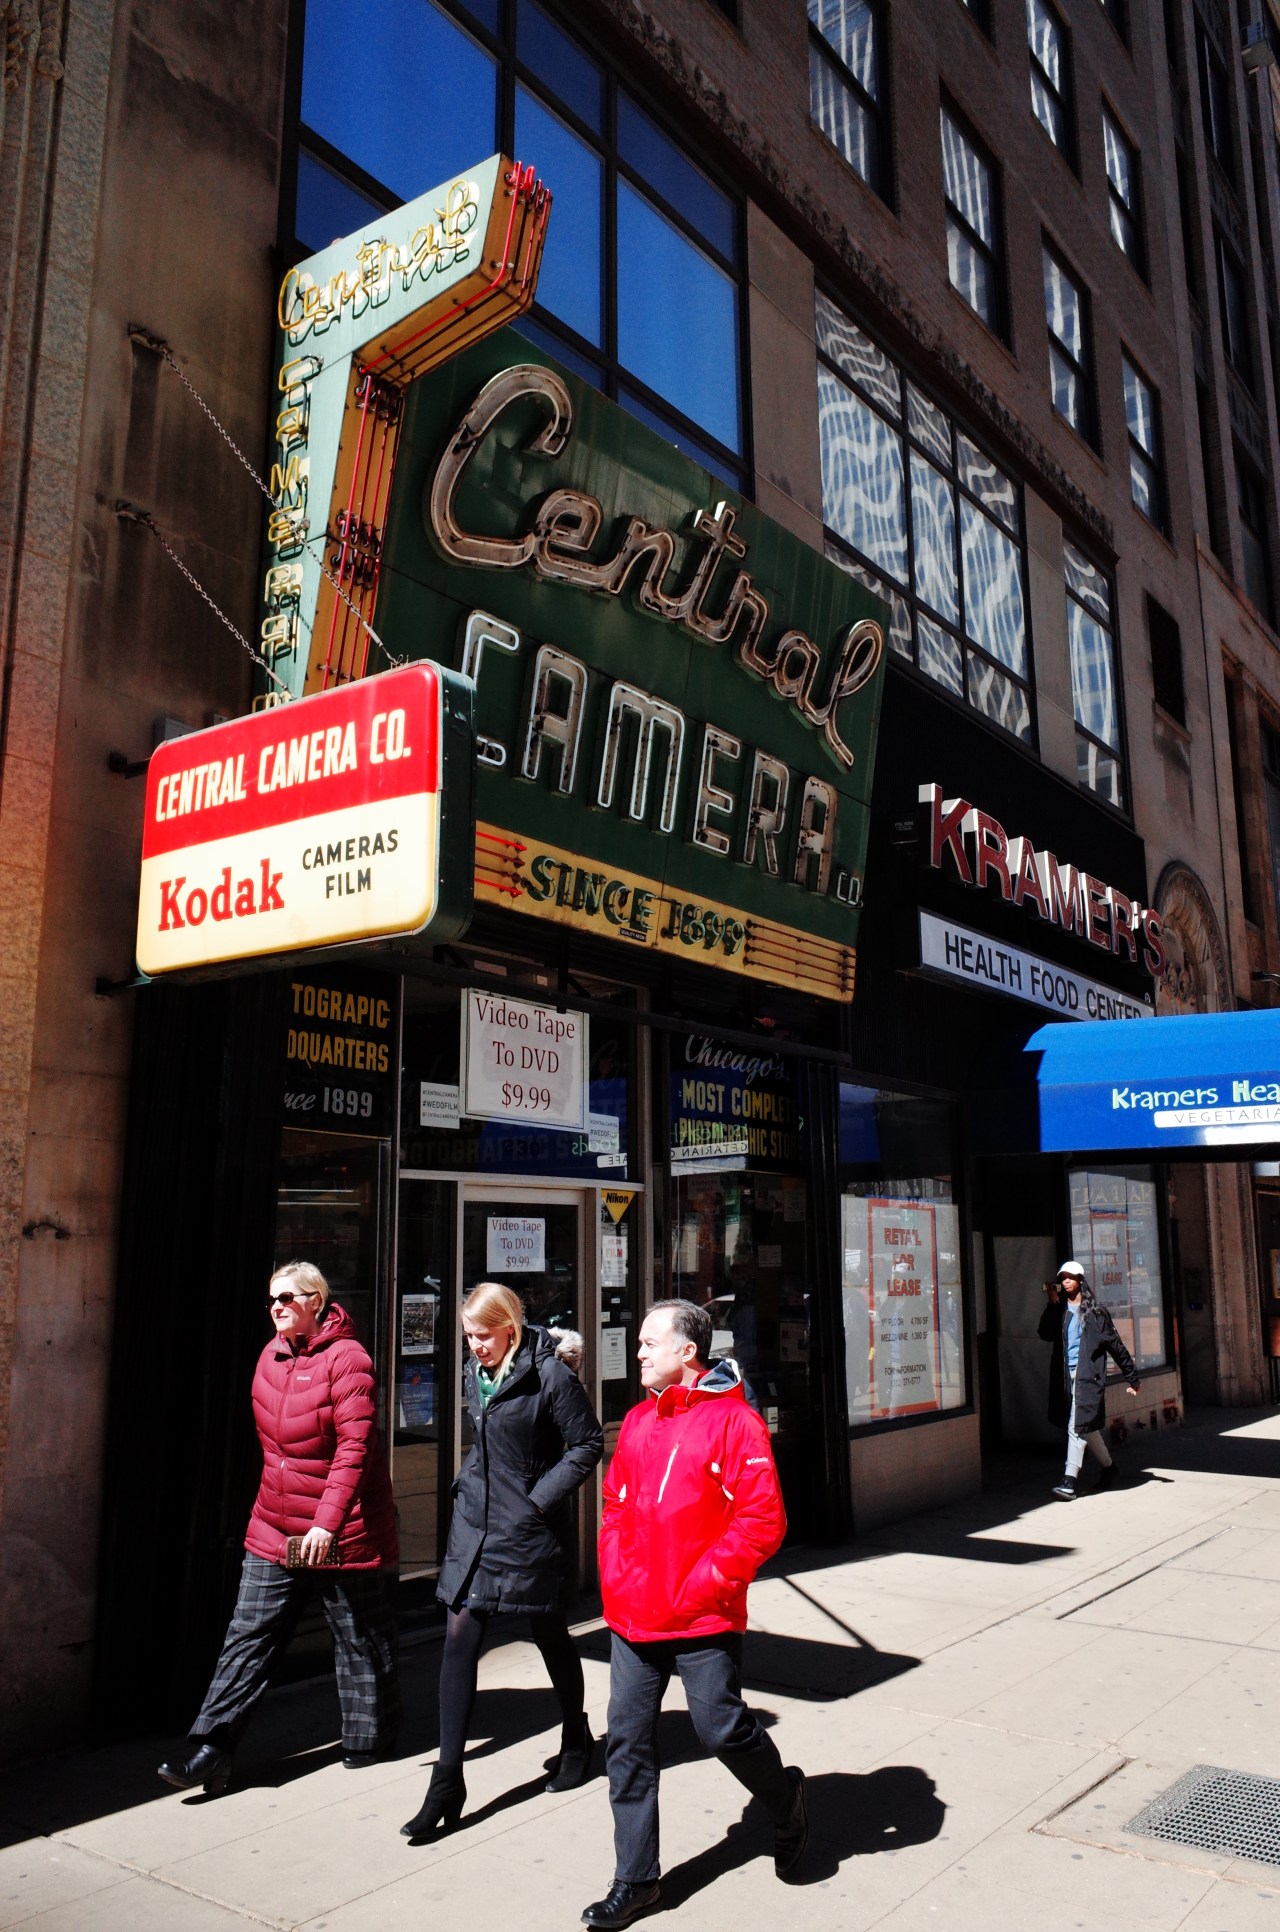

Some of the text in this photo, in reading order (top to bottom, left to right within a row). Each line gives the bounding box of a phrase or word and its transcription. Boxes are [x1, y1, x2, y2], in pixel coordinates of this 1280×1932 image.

[278, 180, 478, 347] Central
[262, 354, 314, 657] CAMERA
[430, 363, 884, 773] Central
[155, 708, 412, 823] CENTRAL CAMERA CO.
[460, 608, 838, 895] CAMERA
[302, 829, 399, 870] CAMERAS
[158, 858, 285, 932] Kodak
[325, 867, 372, 900] FILM
[919, 782, 1167, 977] KRAMER'S
[522, 854, 747, 957] SINCE 1899
[944, 930, 1022, 990] HEALTH
[1031, 966, 1079, 1011] FOOD
[291, 982, 391, 1029] TOGRAPIC
[475, 997, 576, 1043] Video Tape
[287, 1028, 389, 1073] DQUARTERS
[492, 1040, 560, 1074] To DVD
[323, 1086, 374, 1118] 1899
[422, 1100, 458, 1111] #WEDOFILM
[501, 1080, 552, 1111] $9.99
[682, 1078, 726, 1114] MOST
[1112, 1079, 1280, 1110] Kramers Hea
[770, 1129, 800, 1161] STOR
[606, 1192, 629, 1205] Nikon
[491, 1218, 542, 1234] Video Tape
[500, 1237, 534, 1250] To DVD
[505, 1256, 530, 1268] $9.99
[605, 1247, 623, 1258] FILM
[893, 1253, 915, 1271] FOR
[887, 1278, 922, 1297] LEASE
